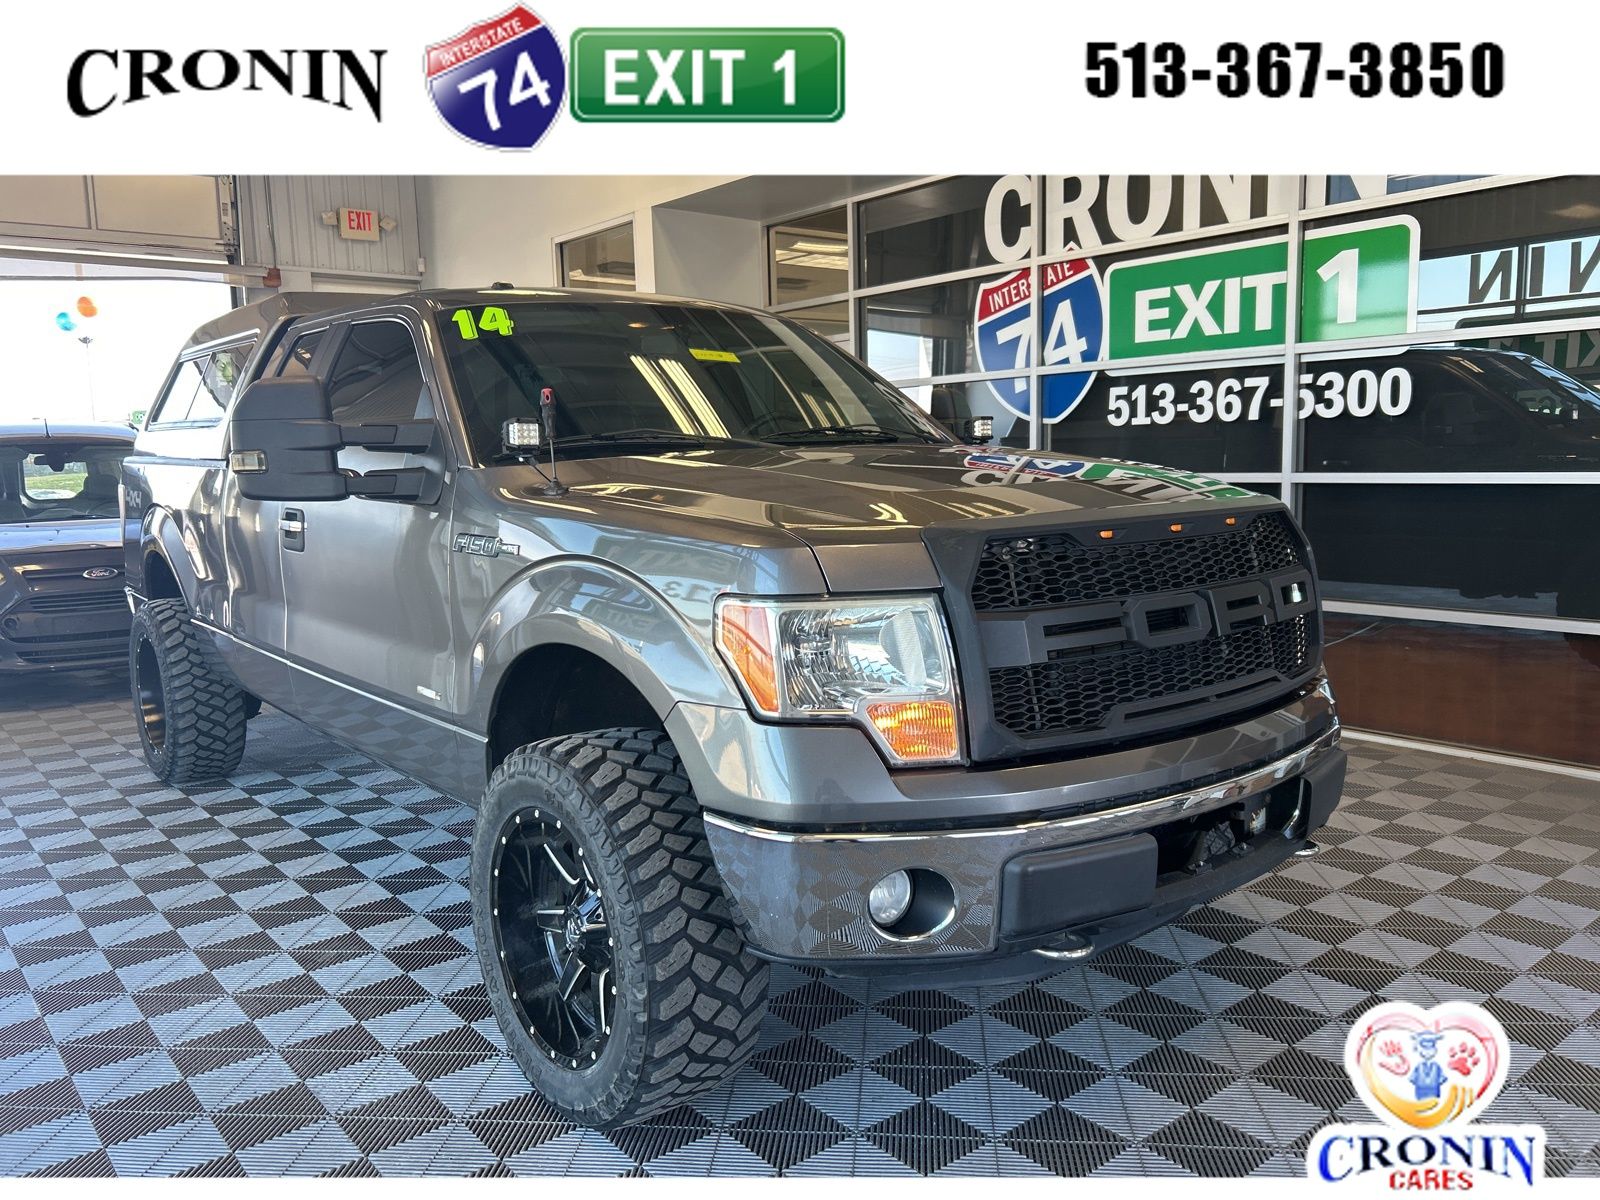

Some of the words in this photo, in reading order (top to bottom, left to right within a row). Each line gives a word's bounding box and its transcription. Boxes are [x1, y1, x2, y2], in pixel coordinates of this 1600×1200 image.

[347, 210, 372, 231] EXIT
[988, 261, 1074, 313] INTERATE
[1134, 271, 1287, 344] EXIT
[1316, 248, 1359, 325] 1
[452, 306, 514, 340] 14
[996, 299, 1087, 394] 74
[1107, 367, 1412, 427] 513-367-5300
[1028, 569, 1317, 664] FORD
